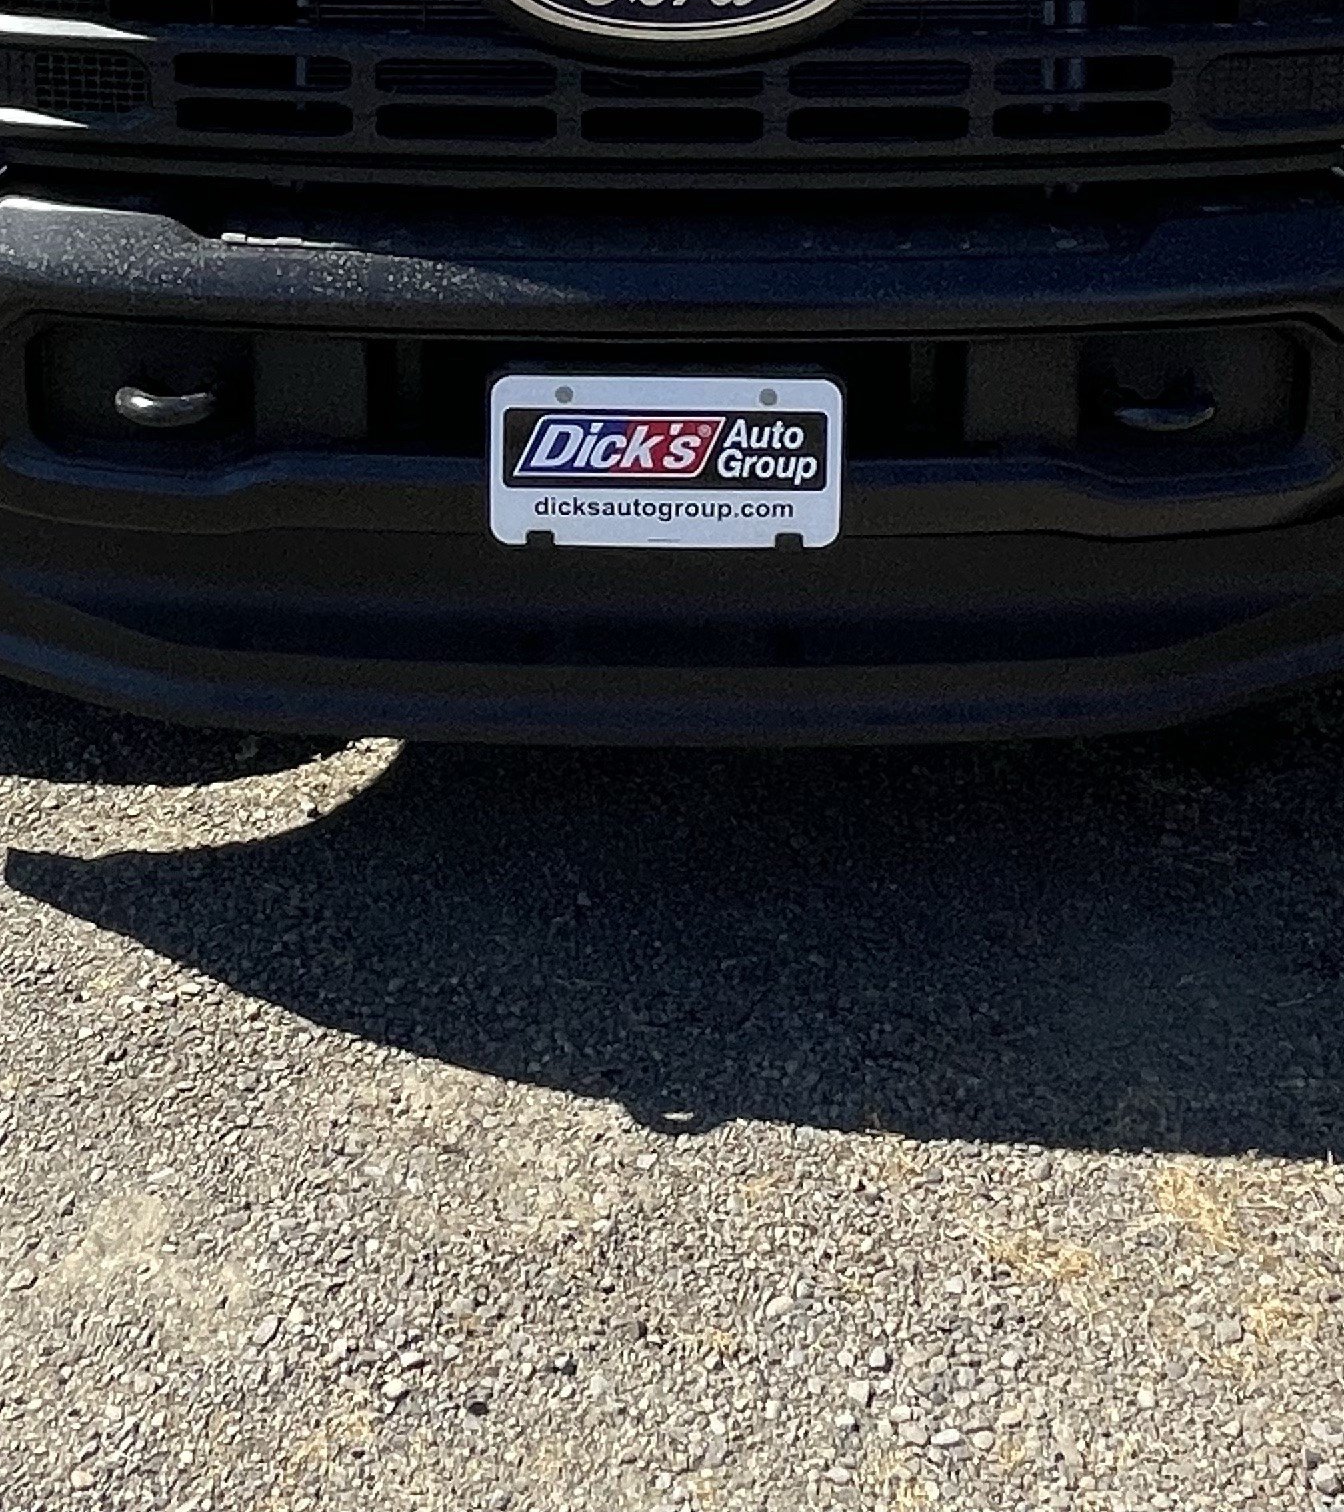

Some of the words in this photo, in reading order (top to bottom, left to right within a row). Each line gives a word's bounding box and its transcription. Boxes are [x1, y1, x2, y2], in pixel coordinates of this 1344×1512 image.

[529, 421, 703, 470] Dick's
[724, 419, 805, 450] Auto
[716, 448, 818, 485] Group
[534, 496, 794, 522] dicksautogroup.com
